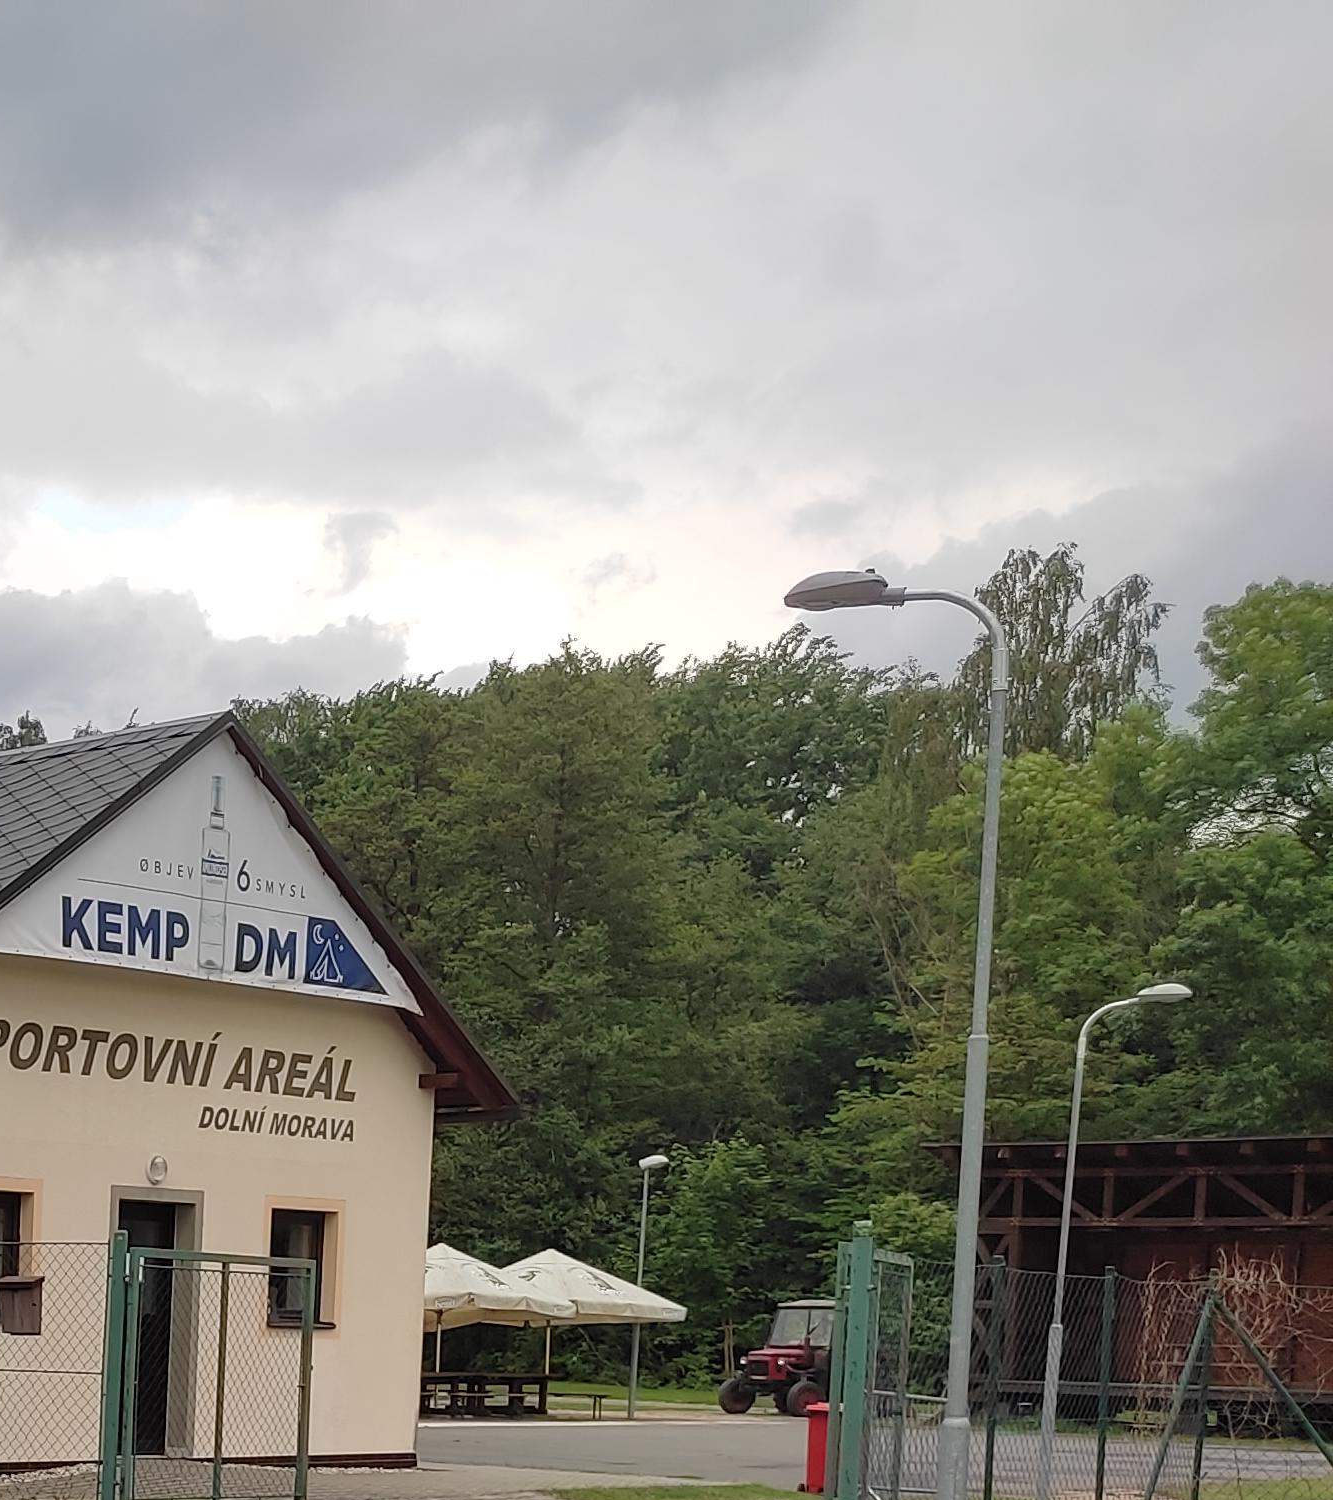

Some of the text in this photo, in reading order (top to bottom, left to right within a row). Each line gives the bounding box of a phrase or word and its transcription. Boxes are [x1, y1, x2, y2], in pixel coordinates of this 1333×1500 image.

[236, 860, 251, 892] 6
[255, 879, 306, 899] SMYSL
[61, 895, 298, 980] KEMP DM
[223, 1045, 357, 1102] AREÁL
[198, 1105, 355, 1142] DOLNÍ MORAVA
